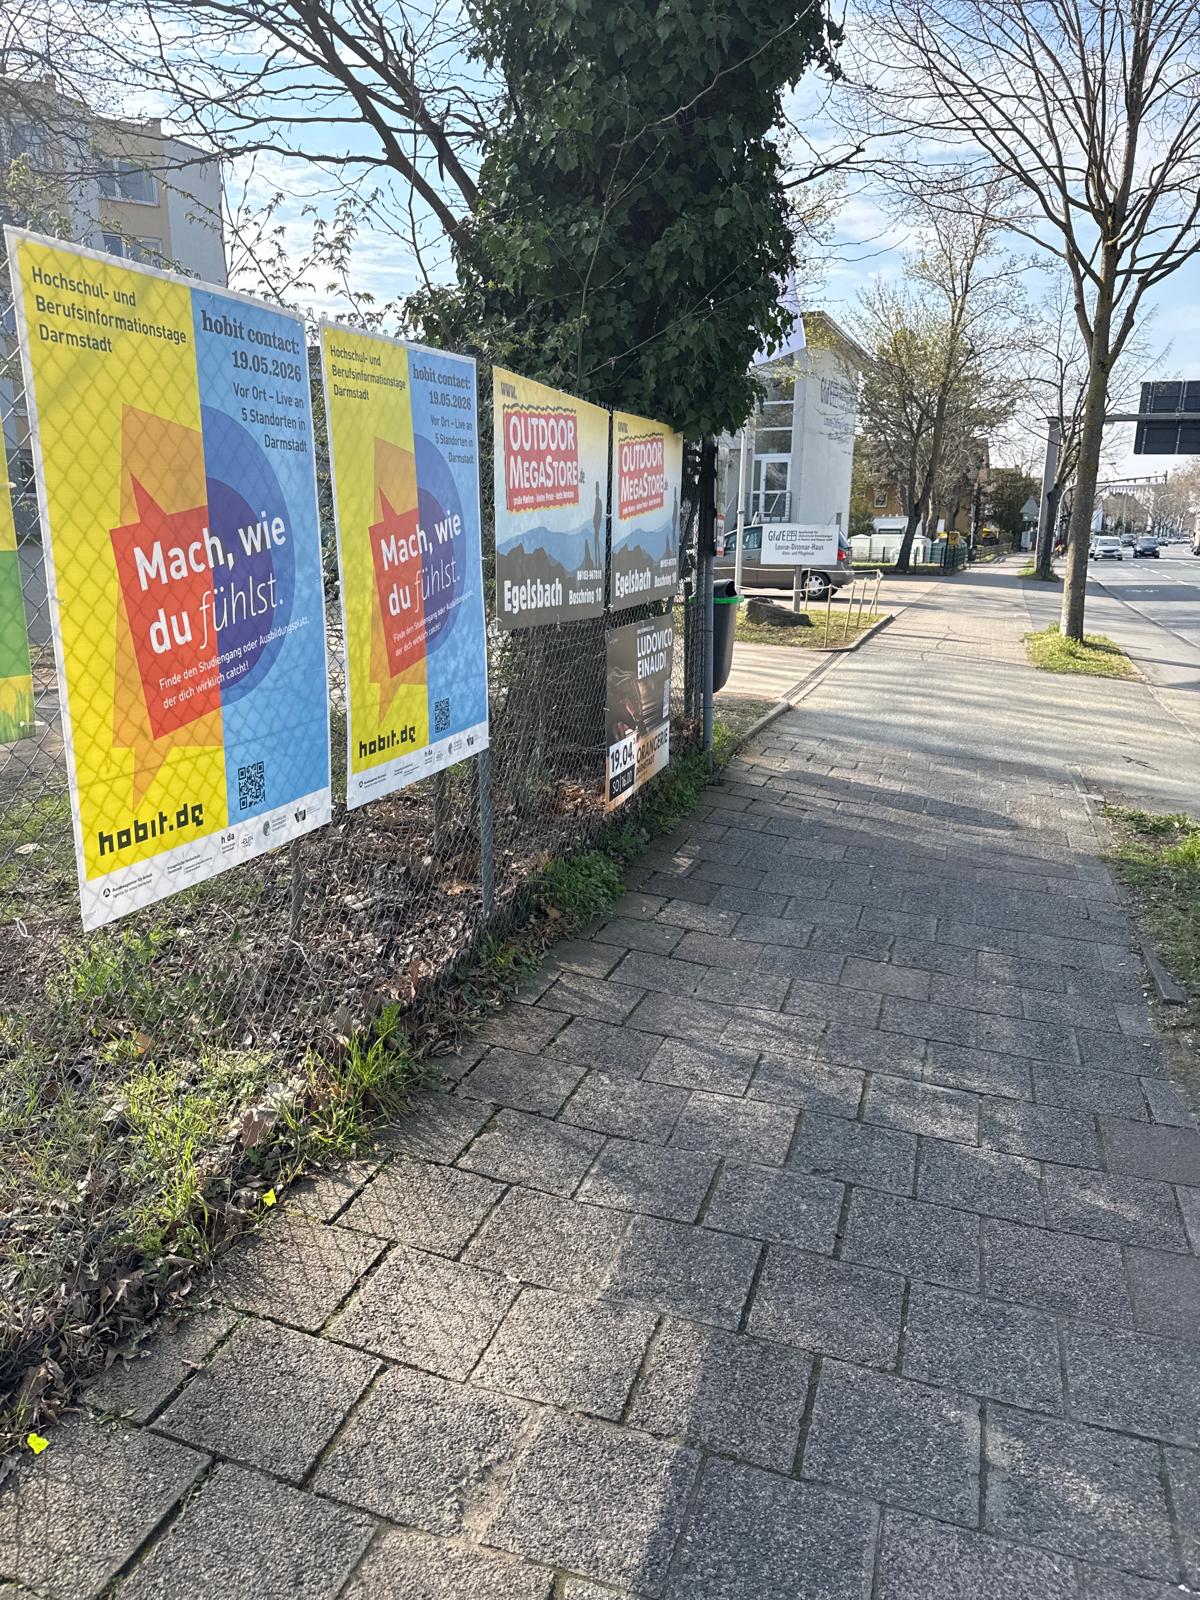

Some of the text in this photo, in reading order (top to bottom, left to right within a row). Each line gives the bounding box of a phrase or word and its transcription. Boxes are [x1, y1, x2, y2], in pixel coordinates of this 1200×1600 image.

[32, 266, 136, 306] Hochschul- und
[36, 295, 186, 344] Berufsinformationstage
[201, 310, 299, 354] hobit contact:
[39, 324, 112, 352] Darmstadt
[232, 351, 301, 381] 19.05.2026
[330, 345, 381, 367] Hochschul- und
[332, 364, 406, 390] Berufsinformationstage
[413, 364, 471, 390] hobit contact:
[233, 382, 249, 398] Vor
[252, 386, 267, 400] Ort
[276, 390, 292, 407] Live
[294, 398, 304, 409] an
[333, 384, 369, 401] Darmstadt
[429, 392, 472, 410] 19.05.2026
[242, 408, 305, 430] 5 Standorten in
[510, 415, 575, 451] OUTDOOR
[264, 434, 307, 452] Darmstadt
[448, 452, 474, 464] Darmstadt
[622, 442, 663, 472] OUTDOOR
[380, 510, 461, 571] Mach, wie
[768, 530, 786, 541] GfdE
[132, 511, 286, 591] Mach, wie
[389, 560, 460, 617] du fühlst.
[503, 578, 562, 613] Egelsbach
[615, 568, 651, 598] Egelsbach
[148, 573, 284, 654] du fühlst.
[637, 627, 673, 658] LUDOVICO
[159, 675, 181, 690] Finde
[183, 666, 198, 680] den
[199, 646, 242, 672] Studiengang
[243, 640, 257, 653] oder
[637, 651, 667, 680] EINAUDI
[163, 660, 249, 709] der dich wirklich catcht!
[610, 742, 635, 773] 19.04.
[636, 726, 669, 764] ORANGERIE
[98, 803, 204, 856] hobit.de
